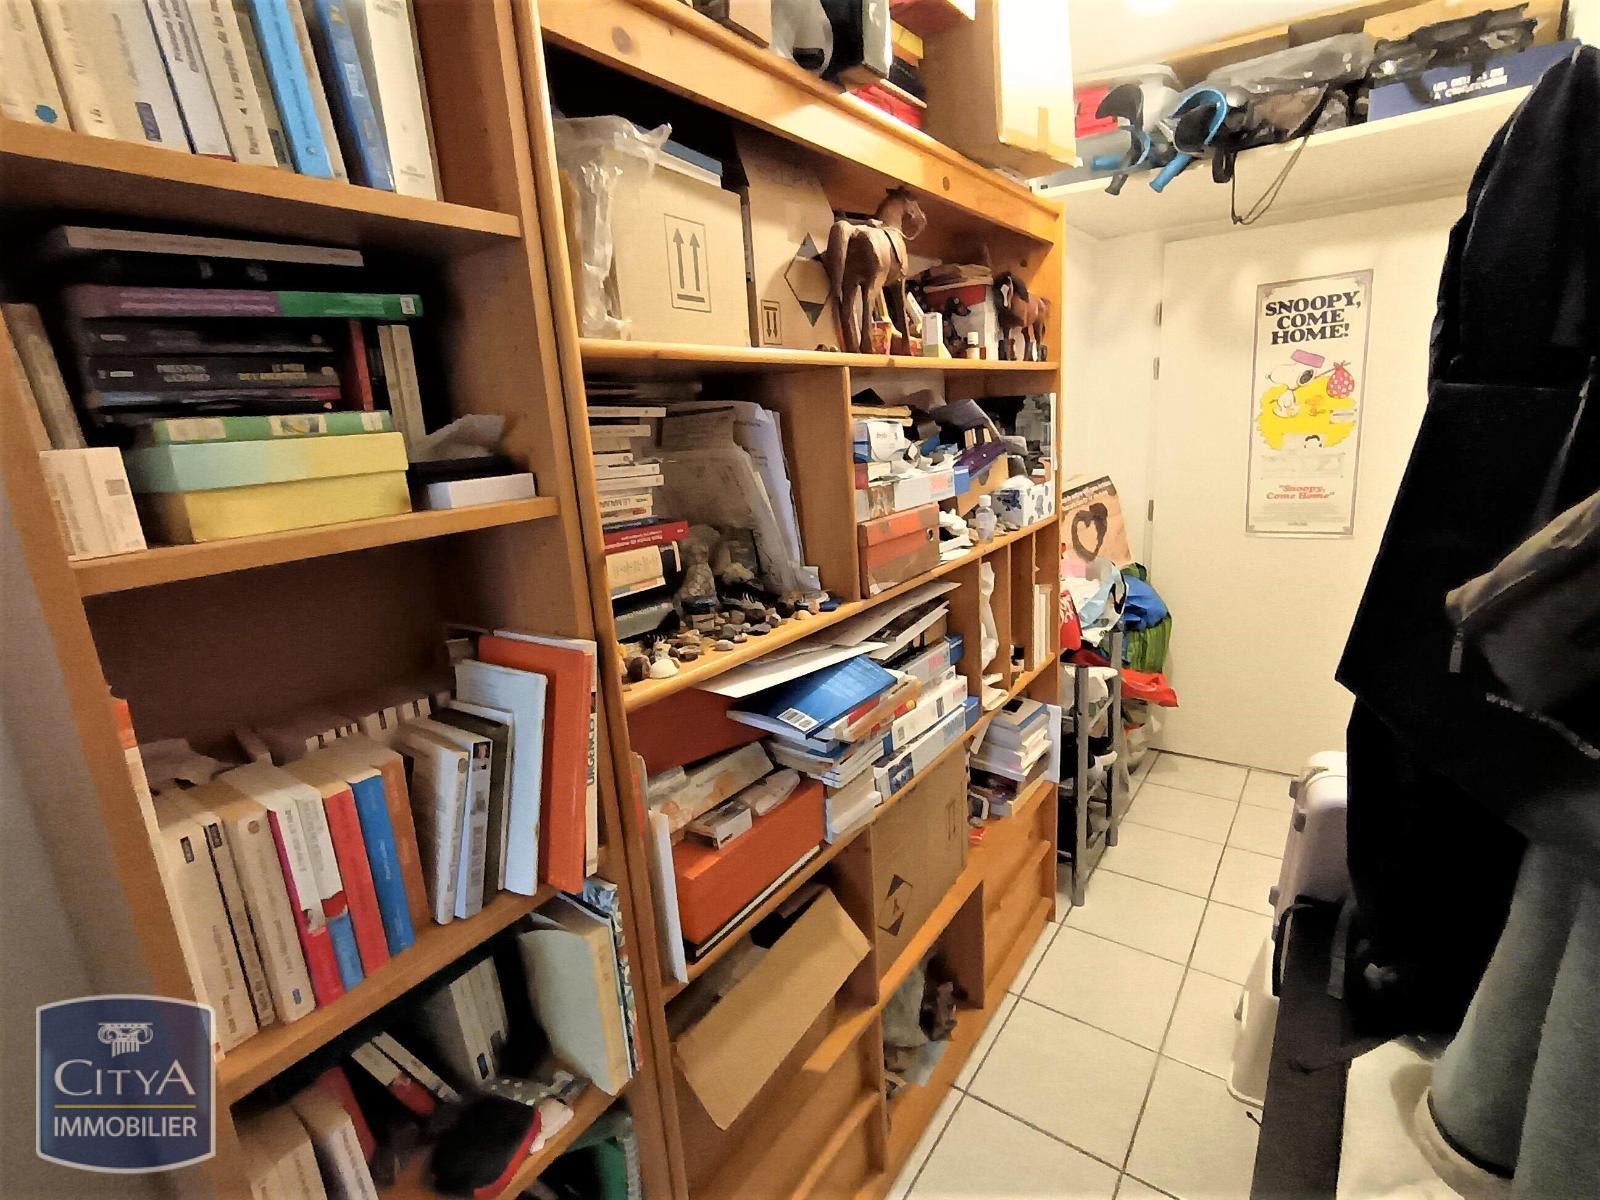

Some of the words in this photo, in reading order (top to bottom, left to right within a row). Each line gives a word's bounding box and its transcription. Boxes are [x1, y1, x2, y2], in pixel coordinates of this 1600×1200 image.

[1265, 291, 1362, 317] SNOOPY,
[1276, 308, 1345, 330] COME
[1271, 323, 1350, 345] HOME!
